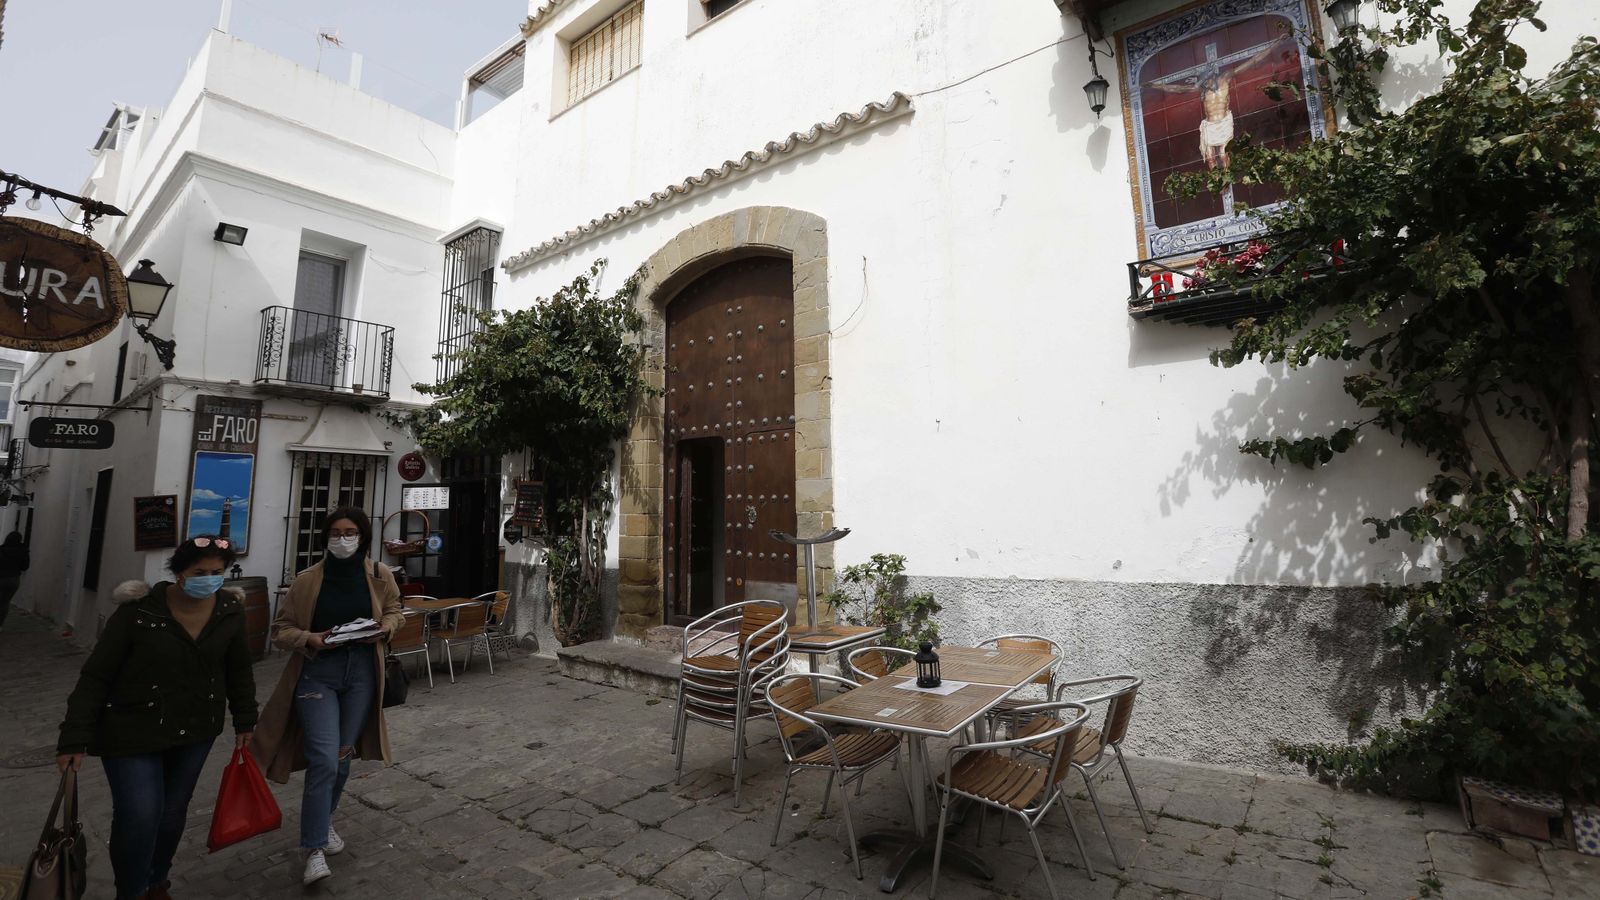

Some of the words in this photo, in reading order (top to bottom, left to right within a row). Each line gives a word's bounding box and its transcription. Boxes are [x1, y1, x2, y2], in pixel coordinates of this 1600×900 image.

[1194, 228, 1226, 242] CRISTO
[54, 423, 99, 436] FARO
[198, 428, 212, 441] EL
[212, 415, 258, 444] FARO
